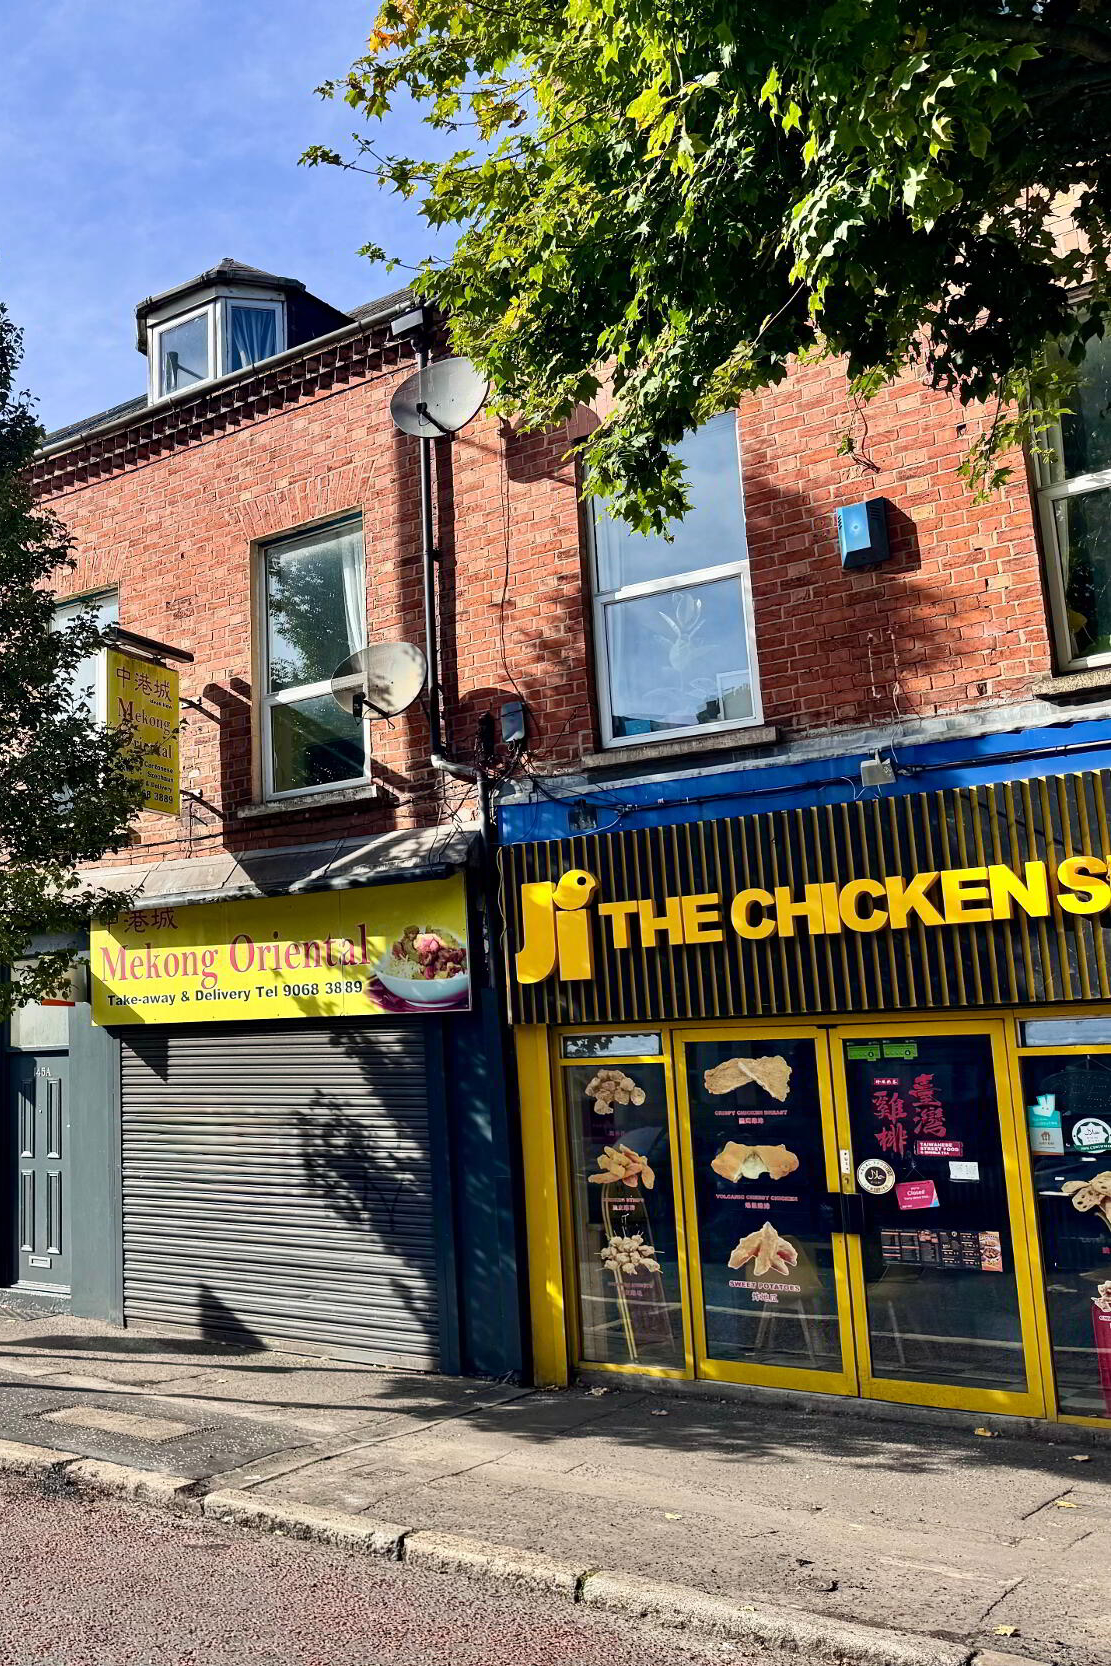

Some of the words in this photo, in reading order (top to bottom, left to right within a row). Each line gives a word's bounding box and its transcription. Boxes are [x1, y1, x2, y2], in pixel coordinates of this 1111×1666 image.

[116, 666, 172, 702] 中港城
[117, 697, 171, 737] Mekong
[153, 791, 174, 805] 3889
[598, 892, 724, 950] THE
[731, 860, 1050, 940] CHICKEN
[1056, 855, 1111, 916] S
[99, 942, 219, 990] Mekong
[230, 922, 370, 973] Oriental
[108, 993, 176, 1007] Take-away
[180, 990, 190, 1002] &
[195, 986, 251, 1002] Delivery
[255, 985, 278, 998] Tel
[283, 982, 320, 997] 9068
[325, 979, 363, 995] 3889
[728, 1280, 757, 1289] SWEET
[758, 1282, 801, 1292] POTATOES
